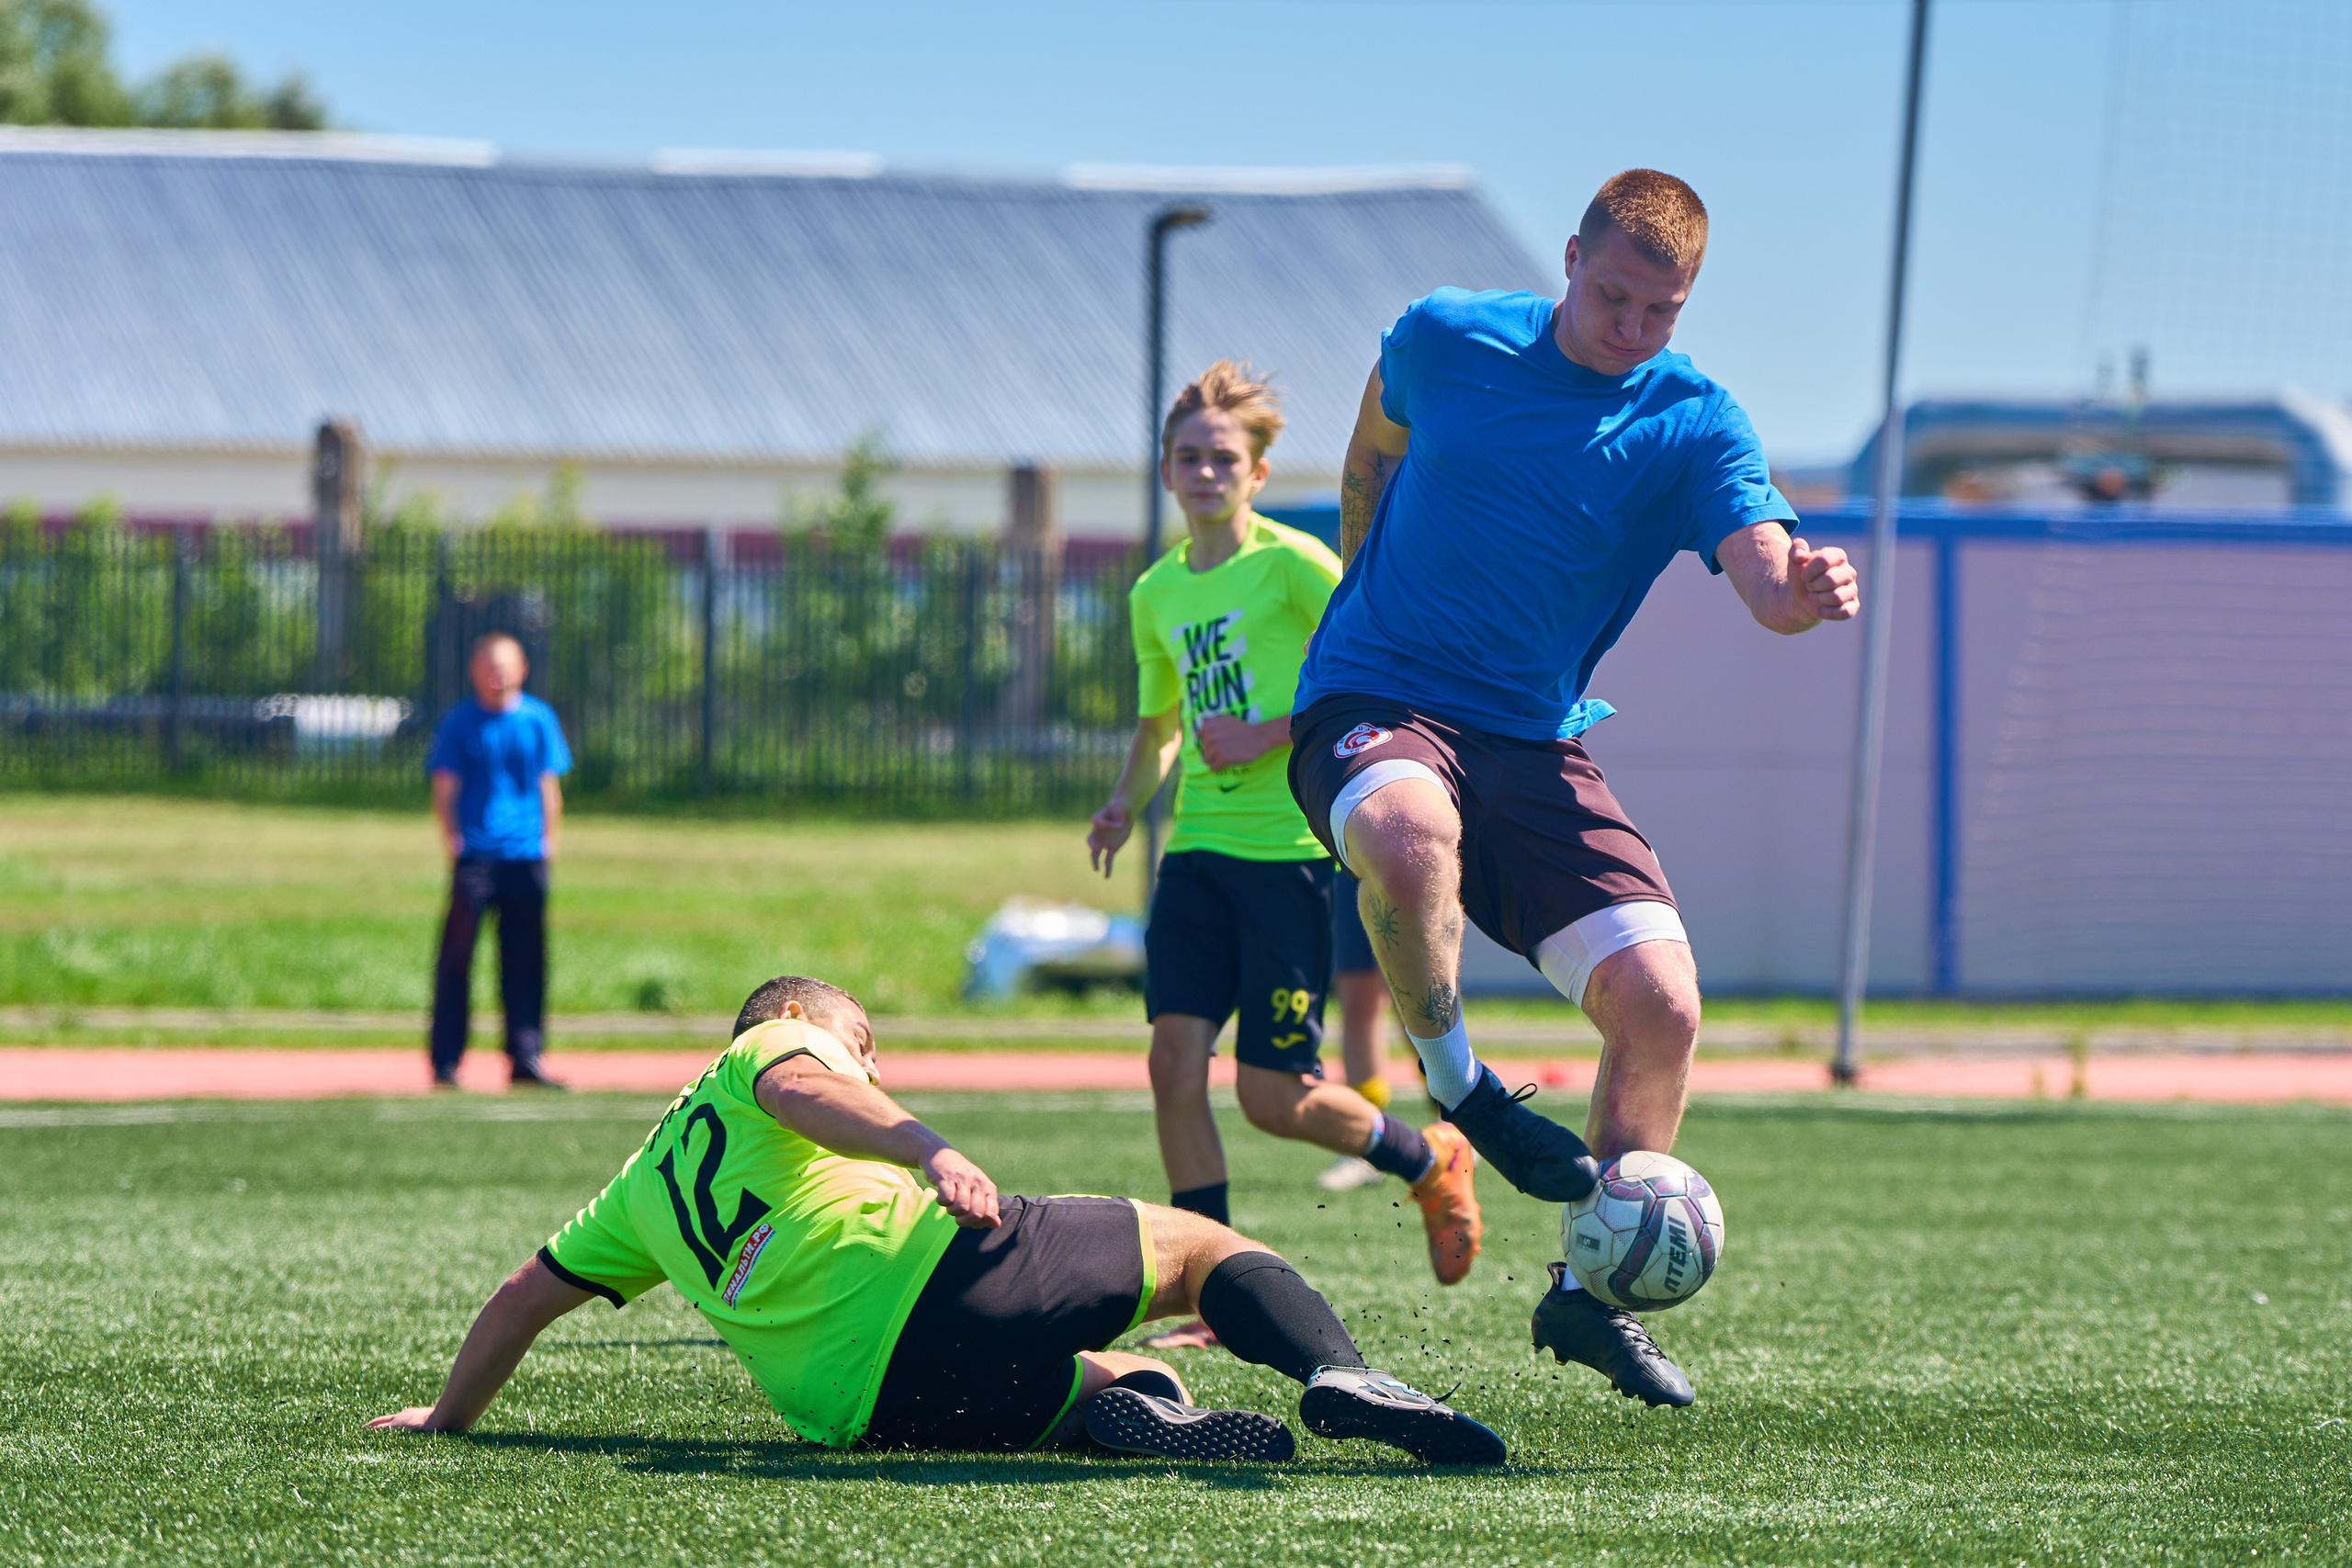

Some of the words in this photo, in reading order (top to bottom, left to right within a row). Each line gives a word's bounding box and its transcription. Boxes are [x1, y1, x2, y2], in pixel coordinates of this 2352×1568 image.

[1184, 615, 1232, 669] WE
[1187, 660, 1250, 713] RUN
[1271, 987, 1310, 1024] 99
[654, 1102, 773, 1292] 12
[722, 1222, 770, 1304] ПЕНАЛЬТИ.РФ
[1664, 1215, 1688, 1294] ATEMI
